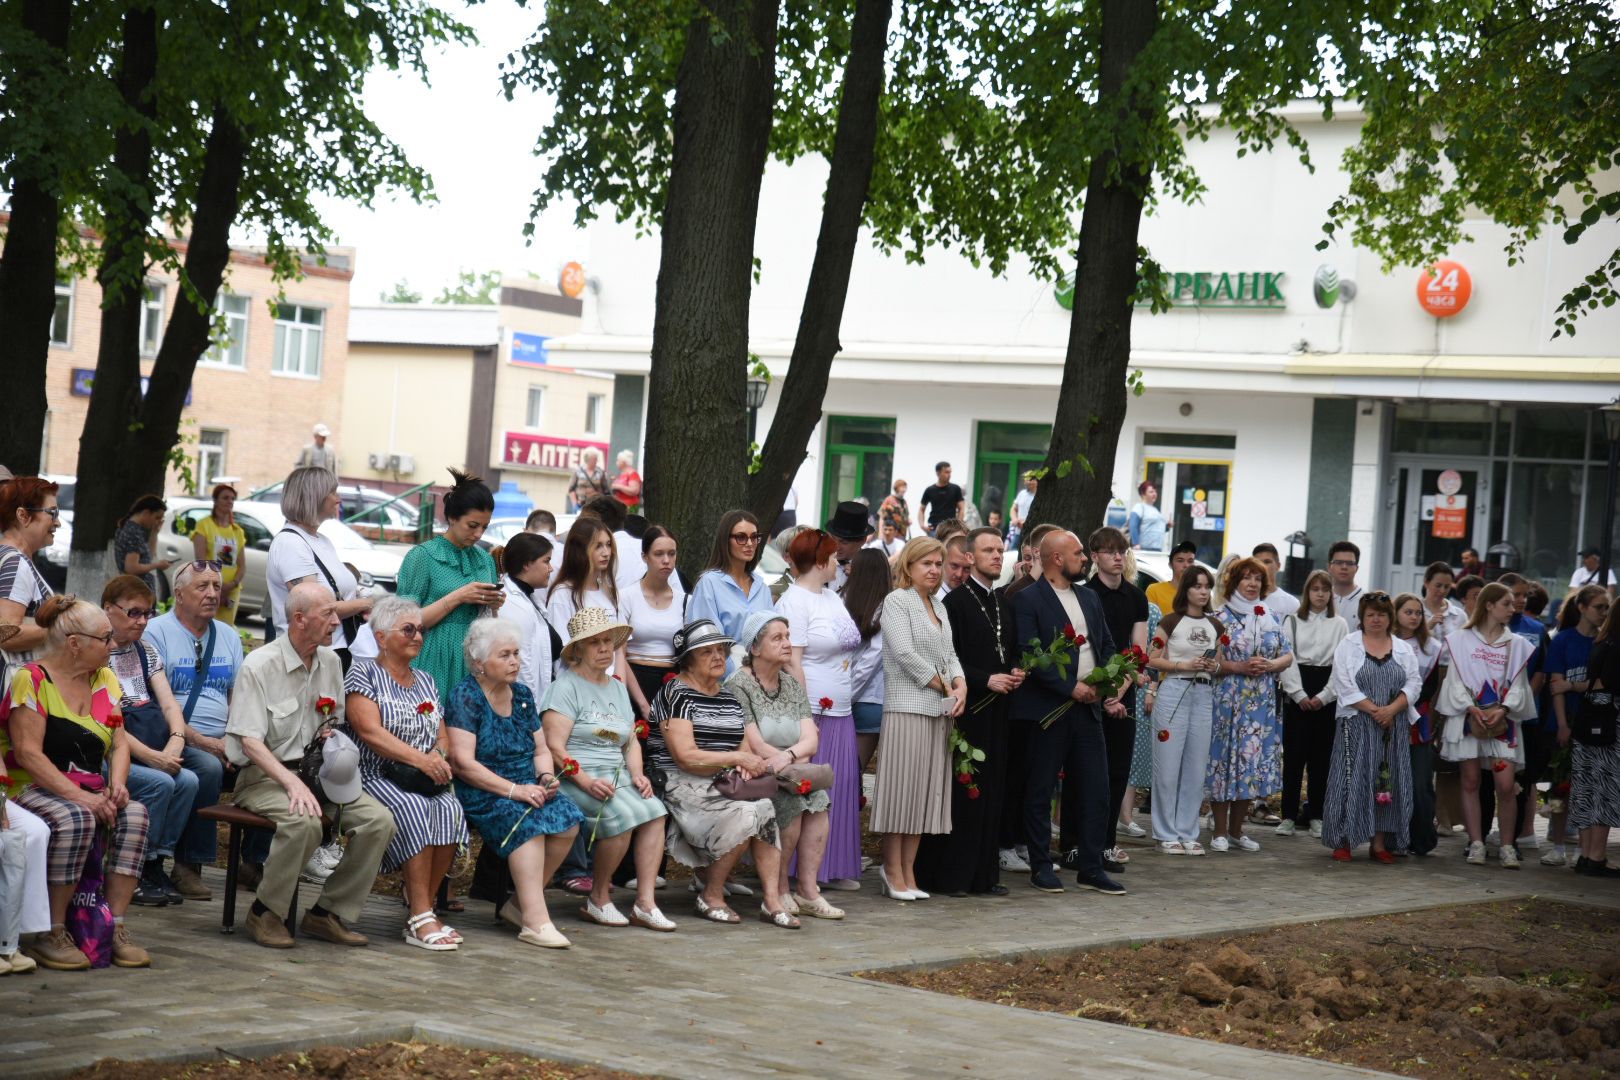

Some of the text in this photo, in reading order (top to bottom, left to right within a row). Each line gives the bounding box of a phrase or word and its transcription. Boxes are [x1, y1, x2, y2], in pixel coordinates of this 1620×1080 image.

[1140, 271, 1286, 301] РБАНК
[1426, 269, 1459, 292] 24
[526, 442, 606, 471] АПТЕА
[211, 656, 227, 664] RAVE
